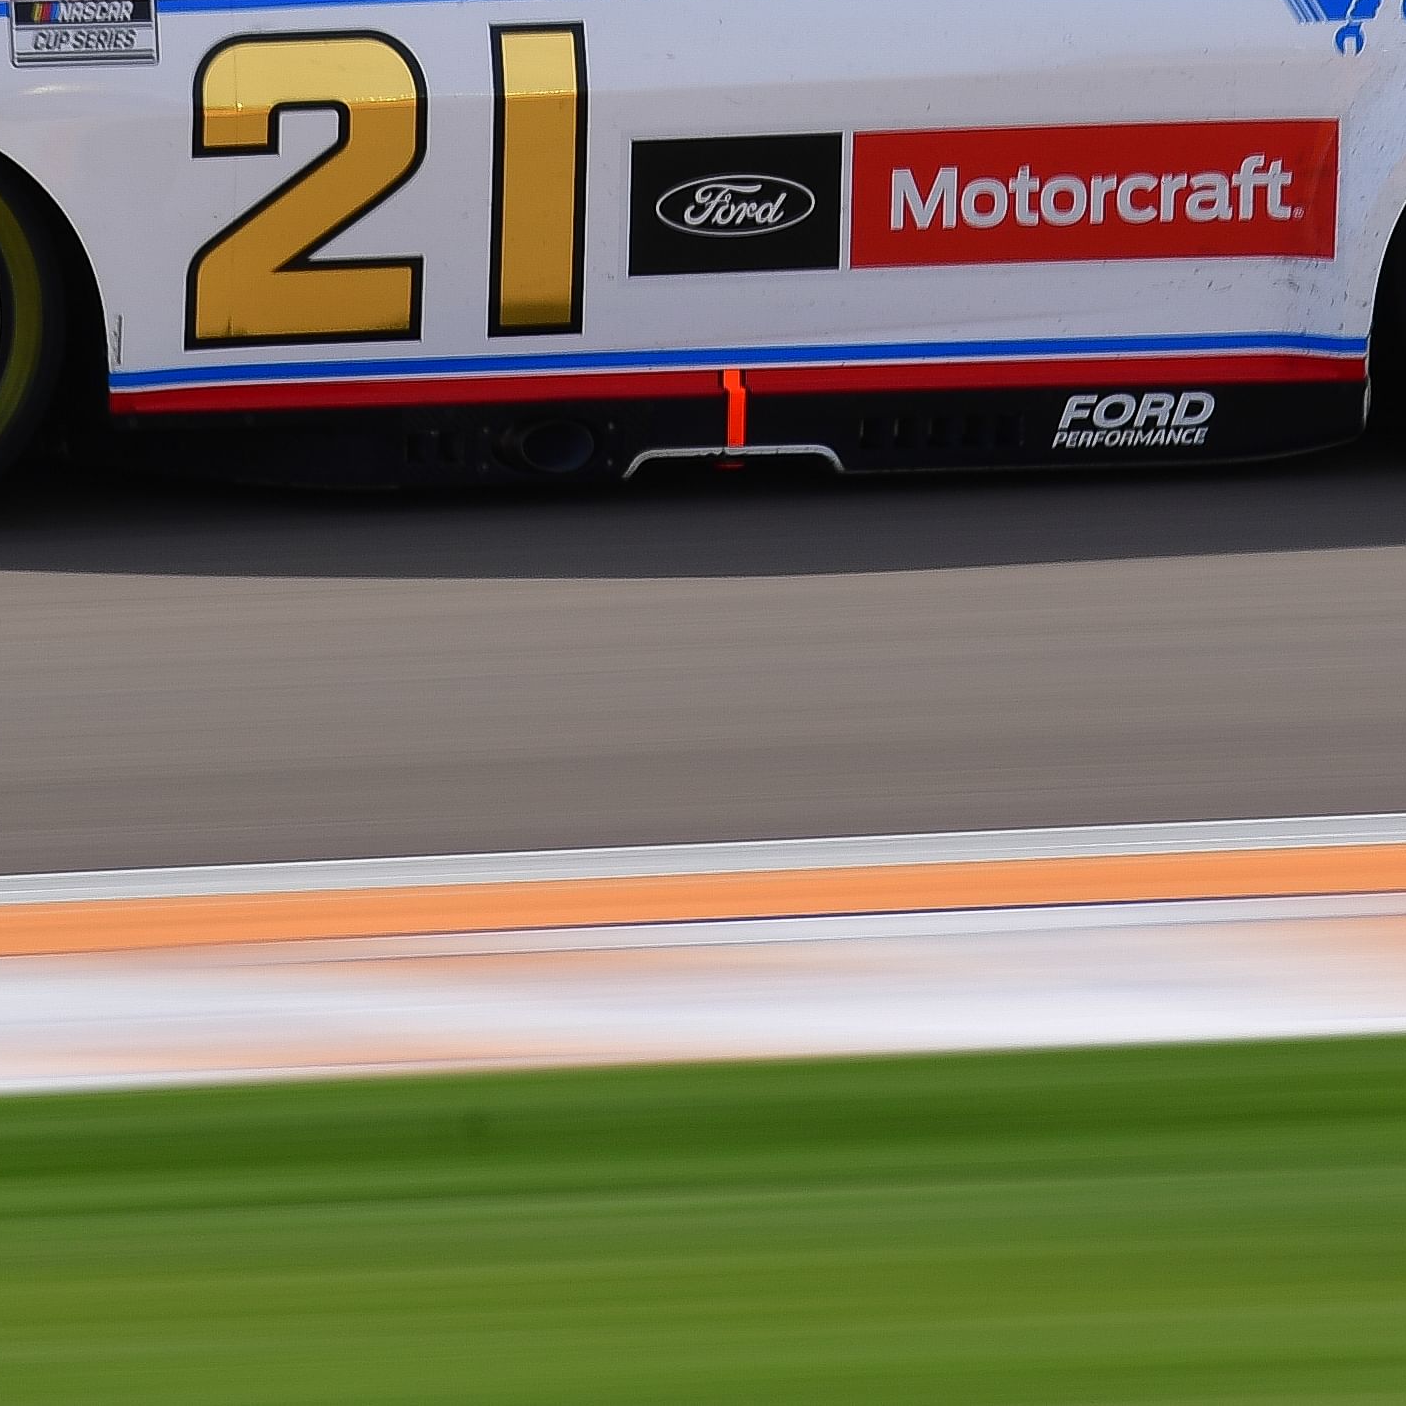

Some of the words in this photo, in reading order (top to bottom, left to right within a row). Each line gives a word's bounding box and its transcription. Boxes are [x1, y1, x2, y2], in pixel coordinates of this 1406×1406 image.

[58, 1, 134, 22] NASCAR
[33, 31, 71, 51] CUP
[71, 29, 137, 50] SERIES
[184, 22, 588, 351] 21
[684, 182, 787, 225] Ford
[890, 152, 1294, 231] Motorcraft
[1058, 391, 1216, 430] FORD
[1051, 427, 1209, 450] PERFORMANCE
